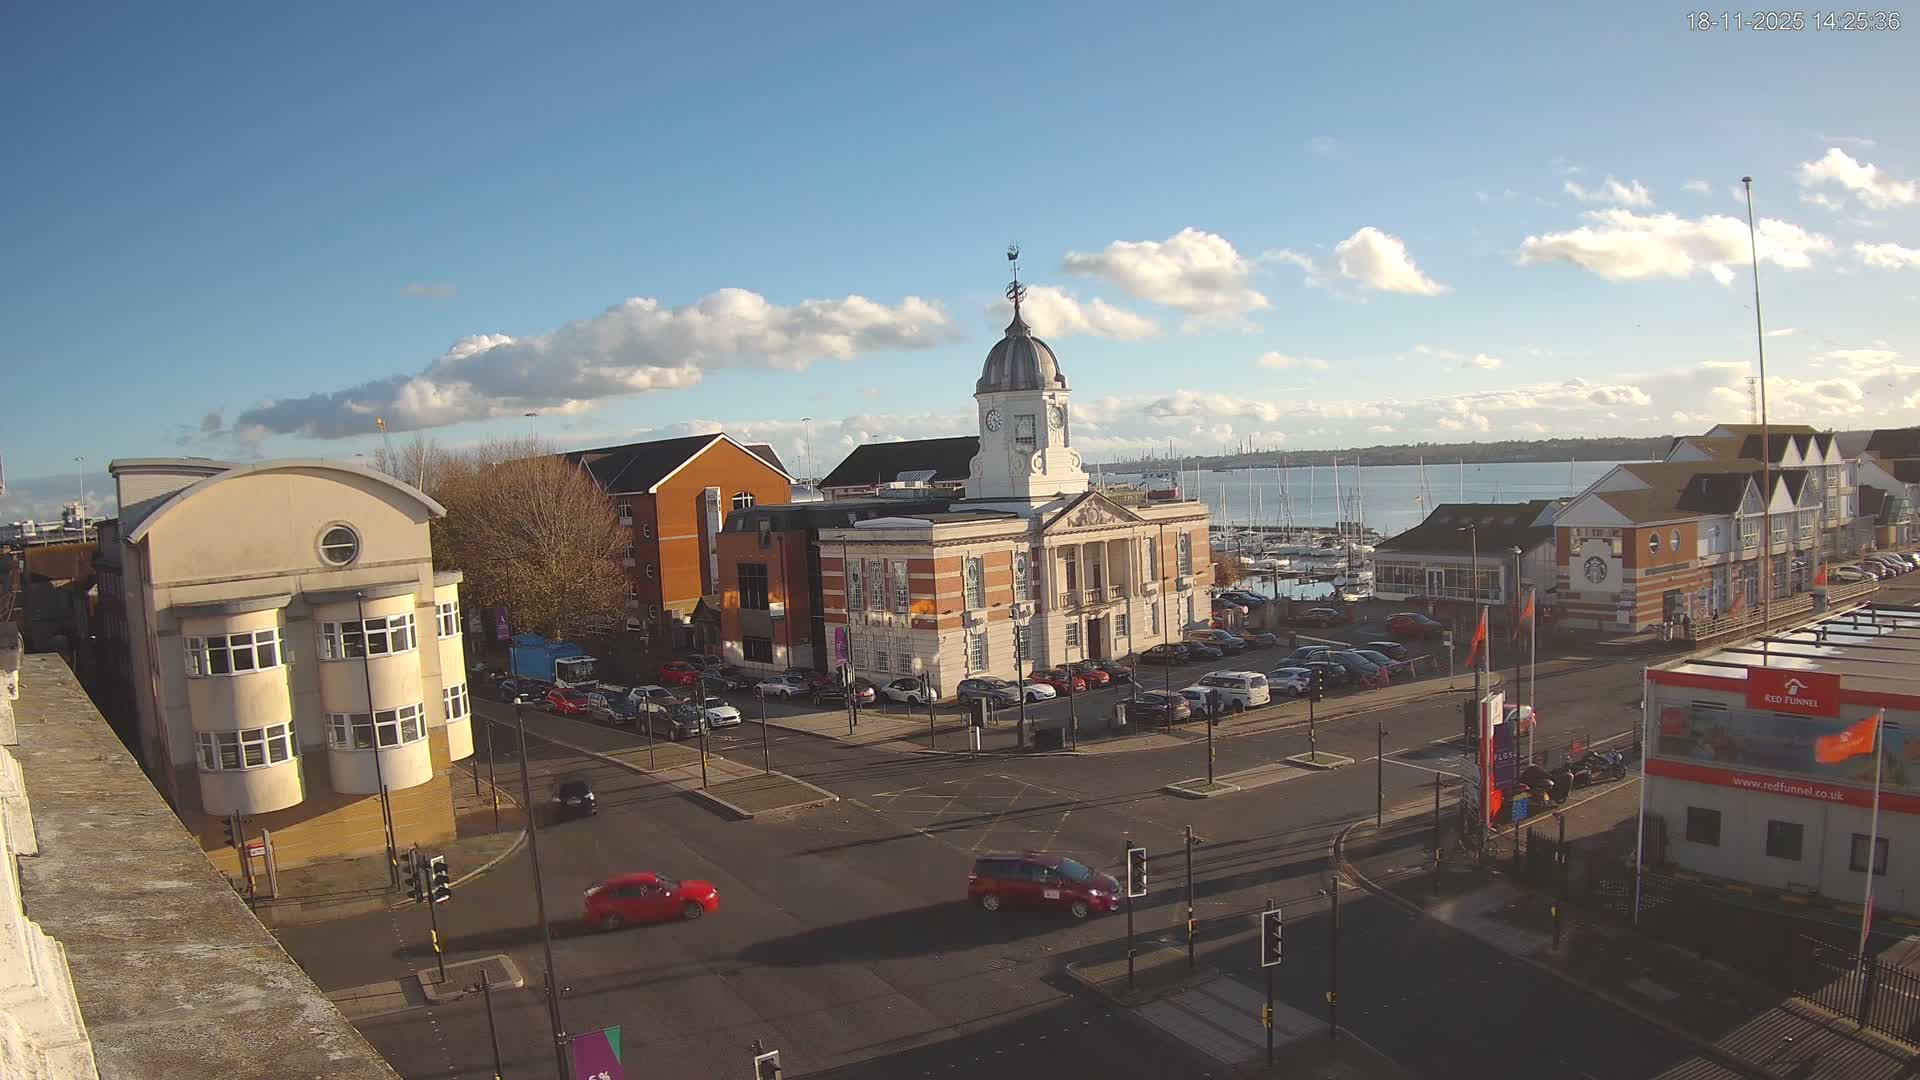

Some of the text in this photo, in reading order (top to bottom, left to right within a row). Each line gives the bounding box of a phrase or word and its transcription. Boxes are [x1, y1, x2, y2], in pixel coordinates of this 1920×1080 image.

[1765, 694, 1818, 708] RED FUNNEL
[1733, 777, 1844, 800] www.redfunnel.co.uk
